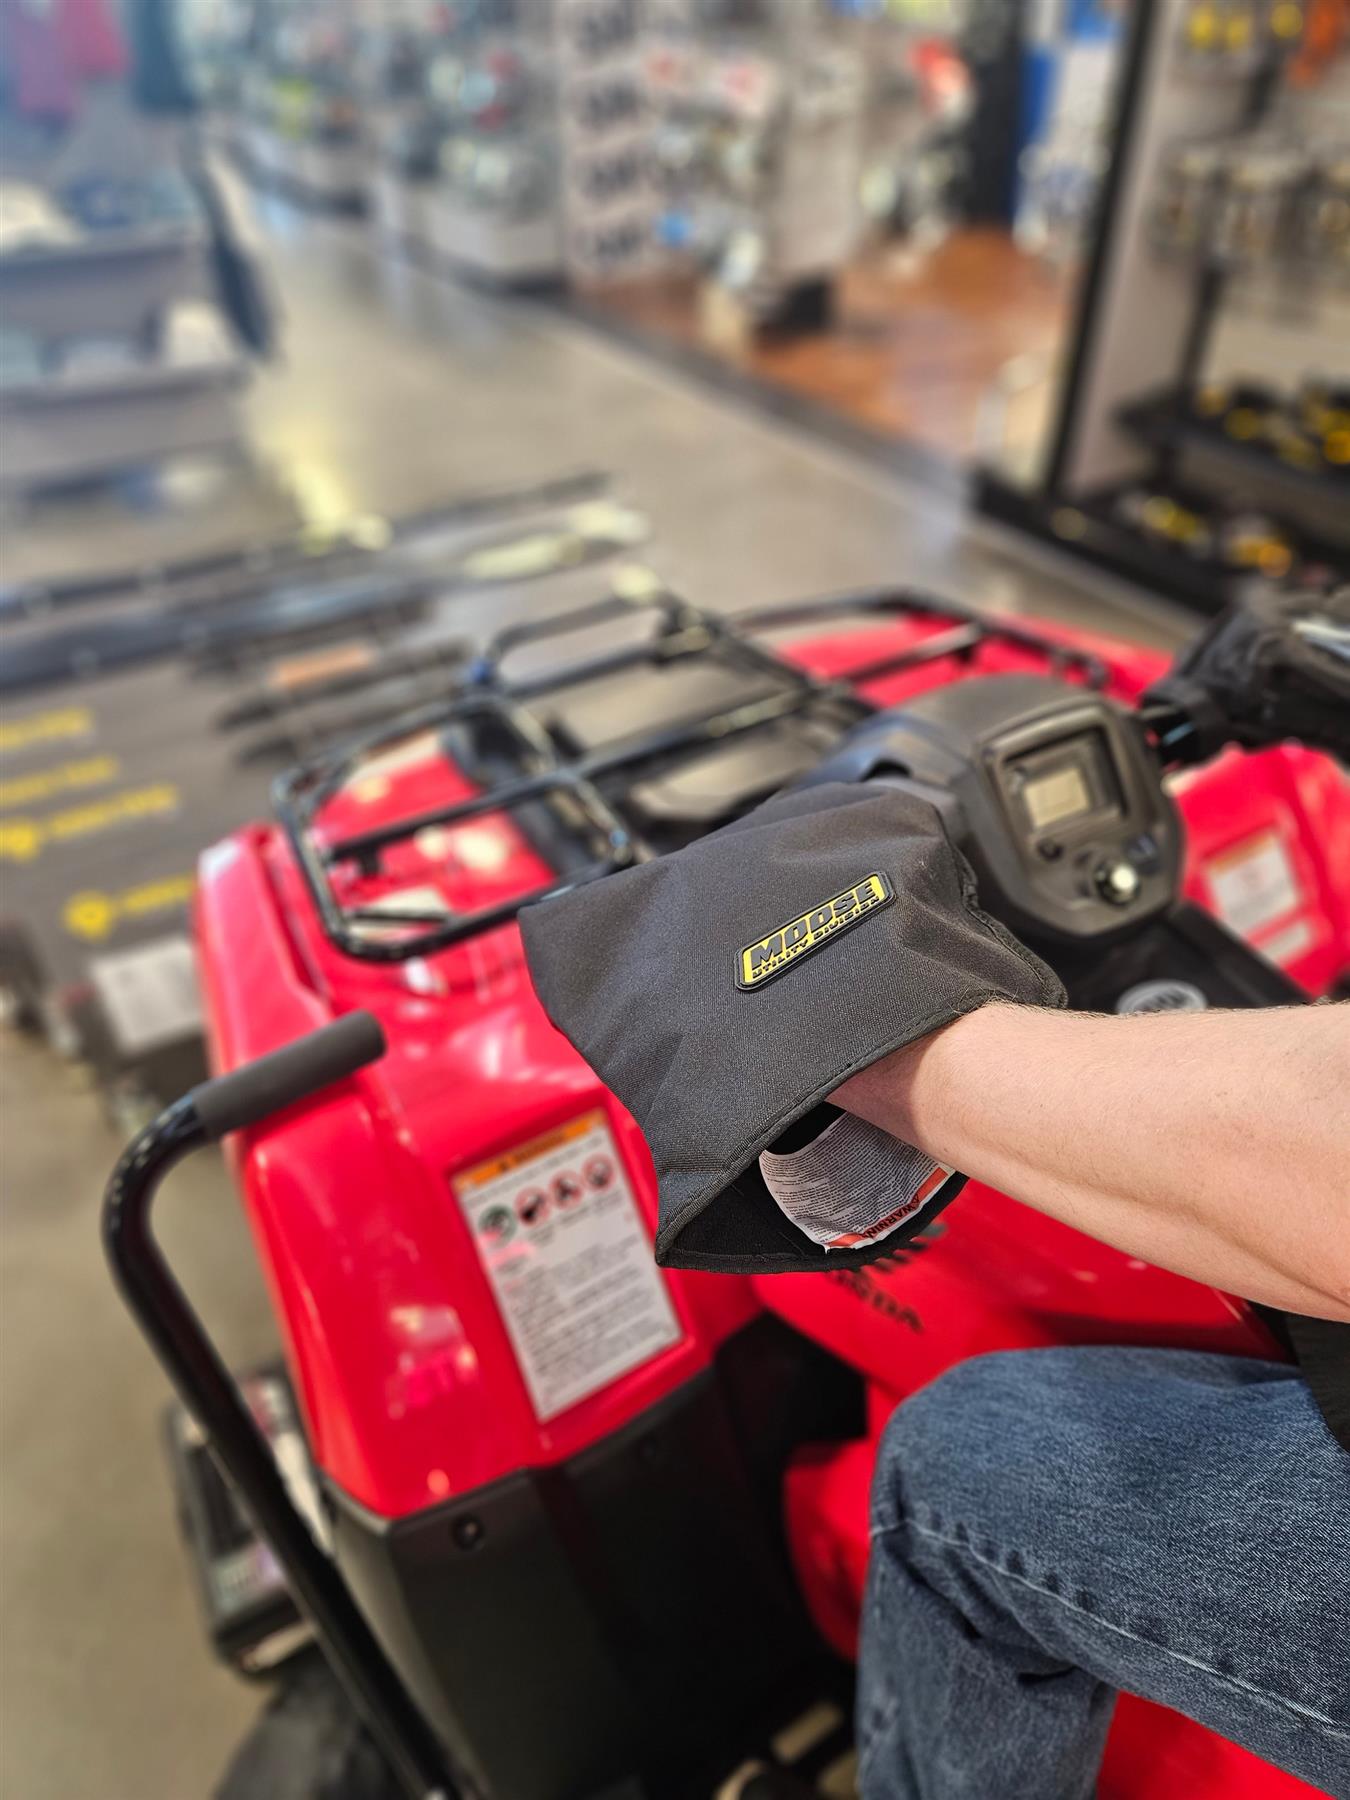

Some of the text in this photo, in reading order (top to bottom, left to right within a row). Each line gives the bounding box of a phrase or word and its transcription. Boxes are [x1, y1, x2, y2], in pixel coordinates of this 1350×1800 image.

[751, 881, 877, 970] MOOSE
[752, 896, 881, 979] UTILITY DIVISION
